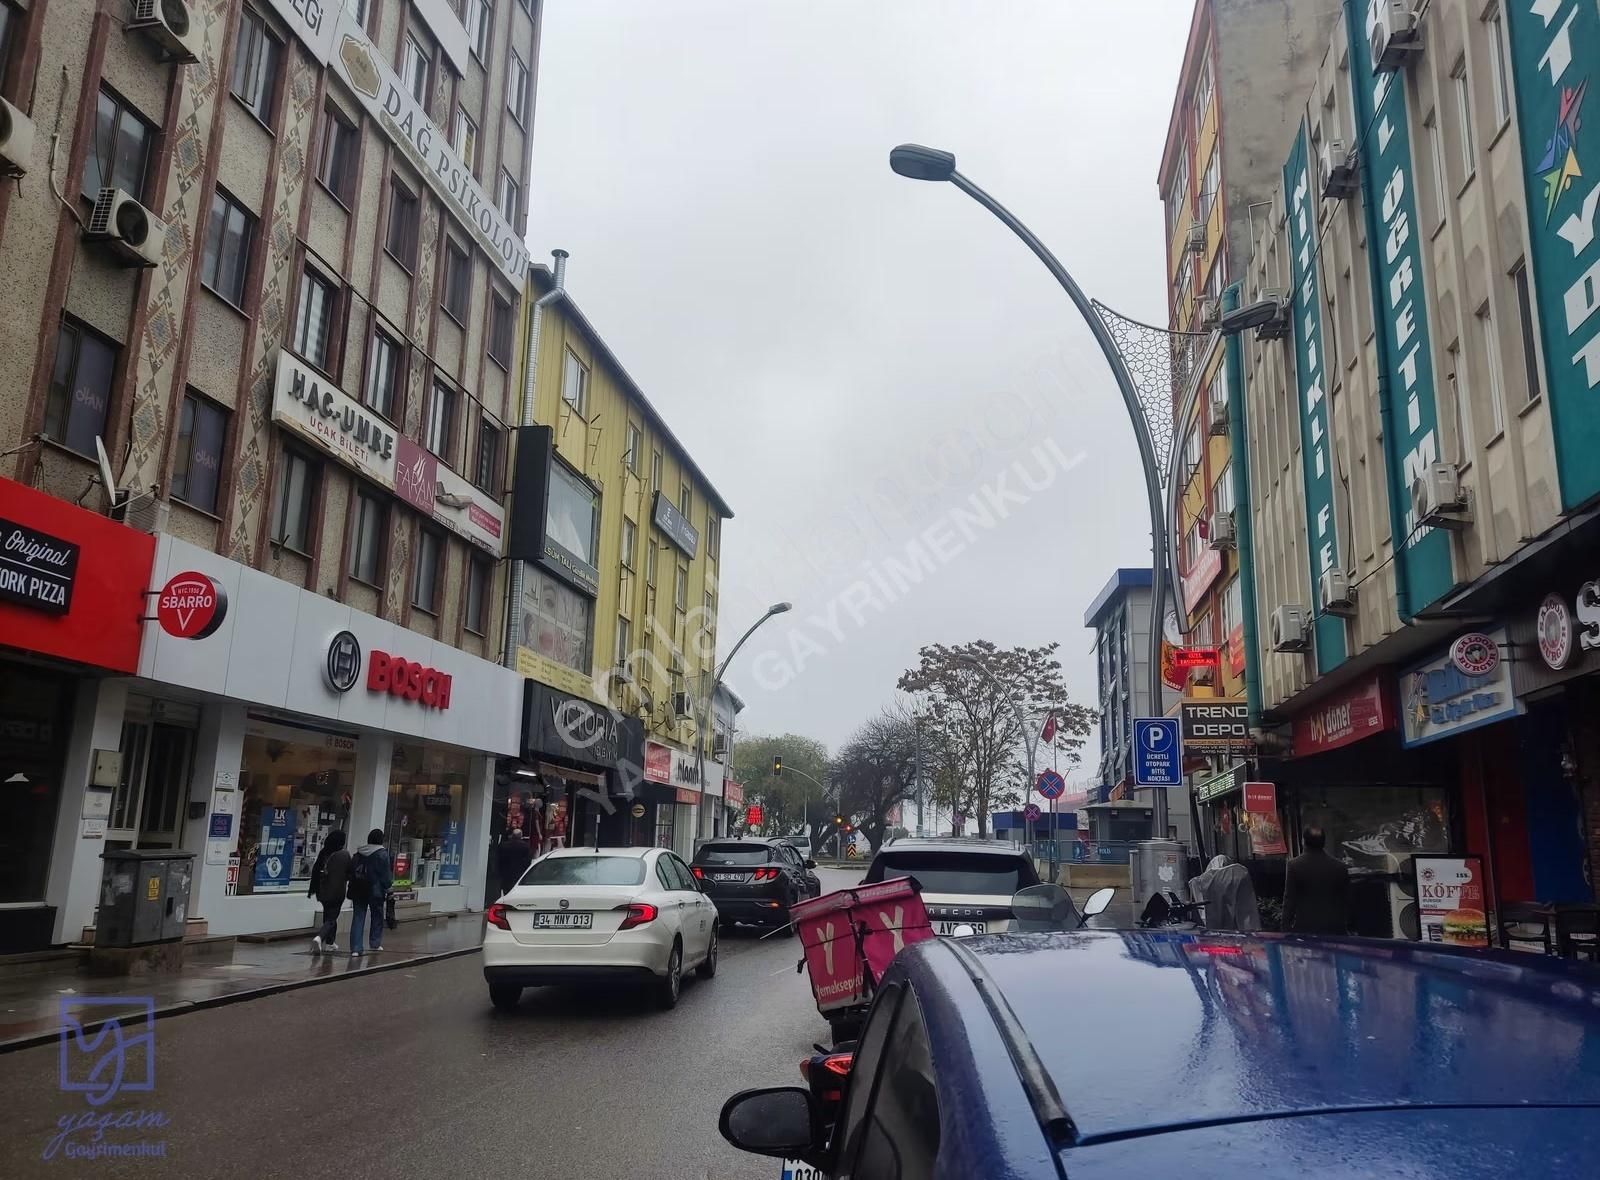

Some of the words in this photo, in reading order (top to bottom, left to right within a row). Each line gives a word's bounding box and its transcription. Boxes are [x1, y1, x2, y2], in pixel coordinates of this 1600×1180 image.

[382, 82, 432, 159] DAĞ
[435, 150, 528, 281] PSİKOLOJİ
[1293, 168, 1326, 480] NİTELİKLİ
[288, 368, 394, 460] HAC-UMRE
[340, 435, 369, 463] BİLETİ
[5, 530, 71, 567] Original
[0, 566, 28, 595] ORK
[29, 577, 66, 606] PIZZA
[162, 595, 213, 609] SBARRO
[1457, 636, 1496, 653] SALOON
[1458, 652, 1497, 672] BURGER
[367, 650, 453, 710] BOSCH
[1186, 706, 1248, 719] TREND
[1150, 727, 1164, 749] P
[1193, 724, 1245, 736] DEPO
[538, 914, 550, 926] 34
[553, 914, 570, 926] MNY
[573, 914, 590, 926] 013
